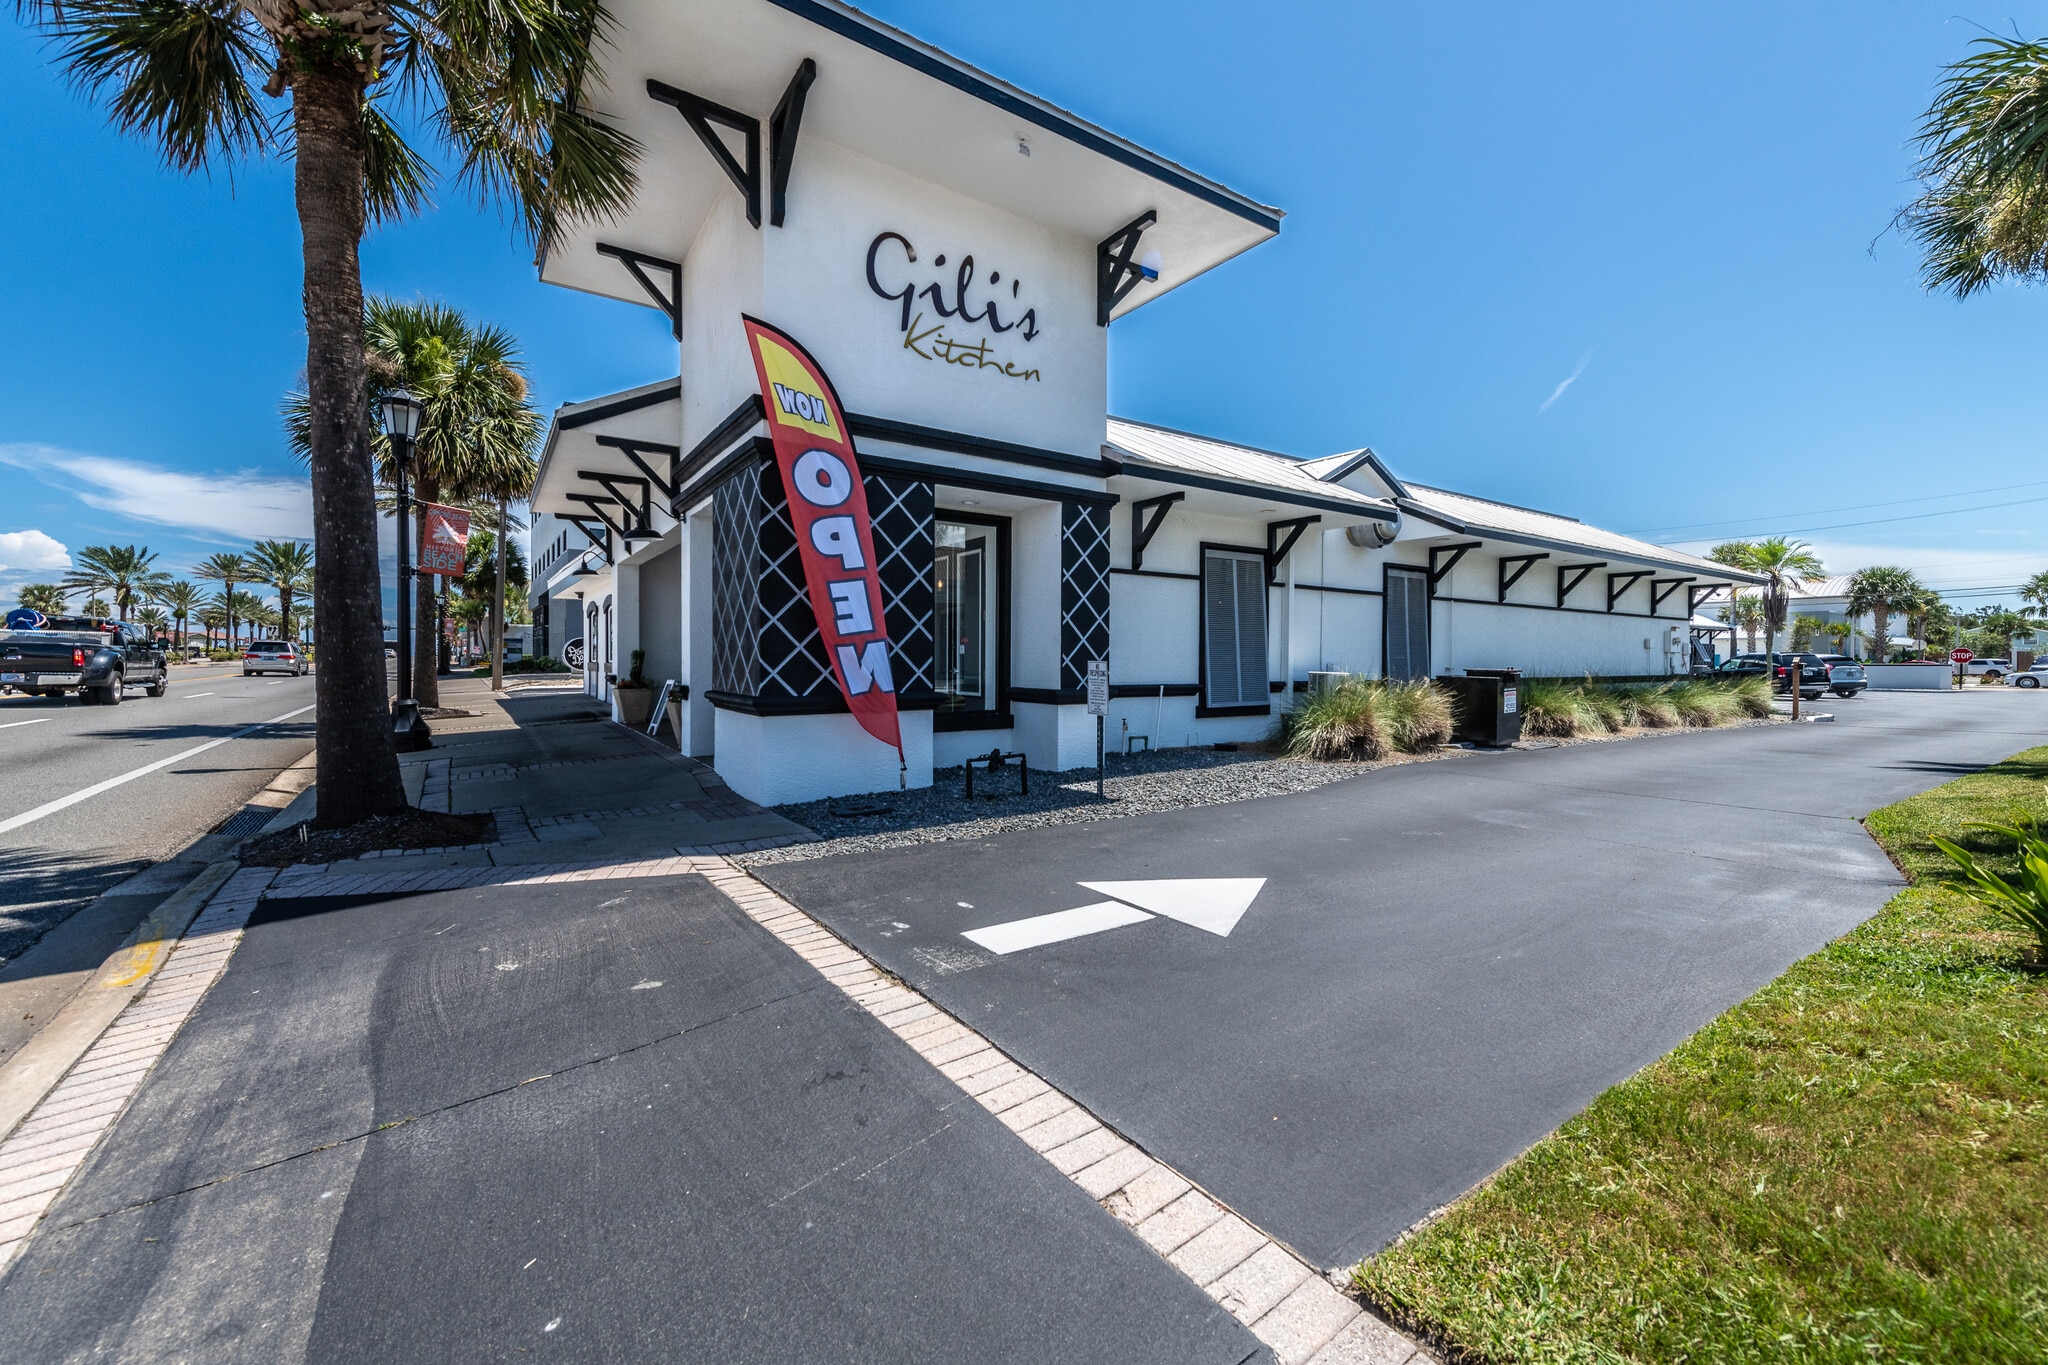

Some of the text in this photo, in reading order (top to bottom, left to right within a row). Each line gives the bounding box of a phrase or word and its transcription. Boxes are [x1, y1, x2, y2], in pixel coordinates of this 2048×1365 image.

[866, 231, 1039, 342] Gili's
[904, 312, 1040, 382] Kitchen
[423, 557, 457, 571] SIDE
[424, 549, 463, 563] BEACH
